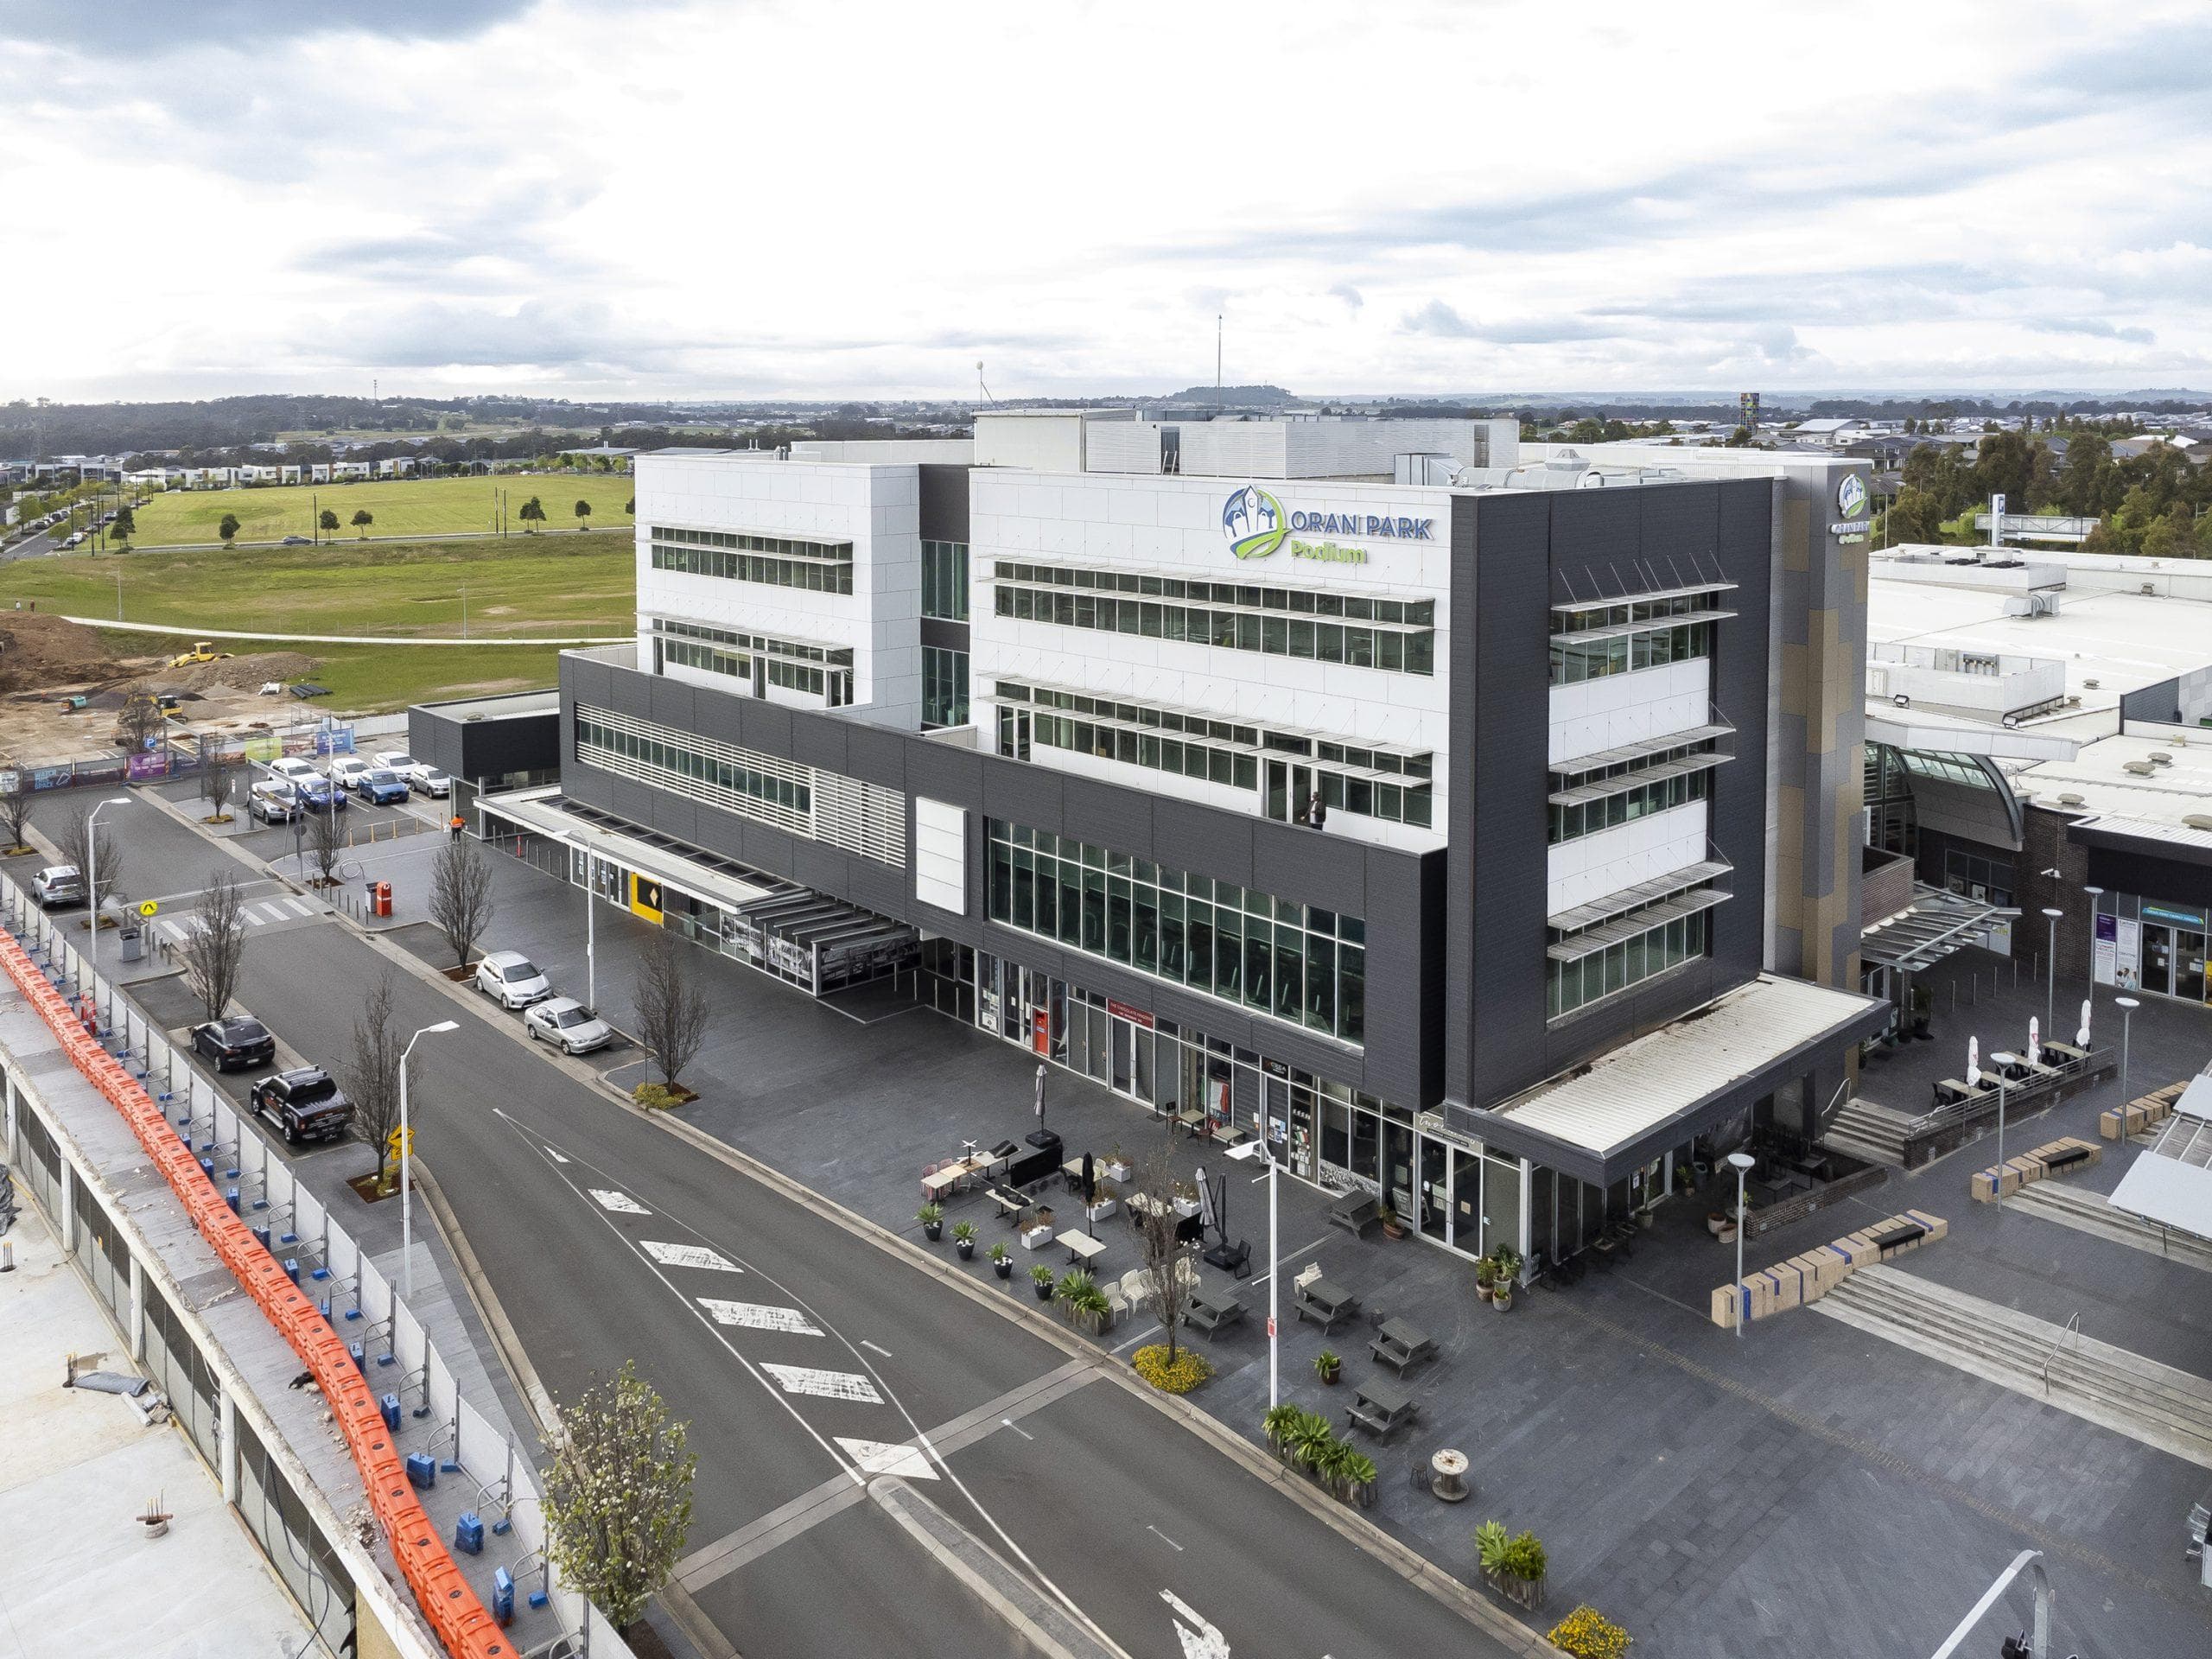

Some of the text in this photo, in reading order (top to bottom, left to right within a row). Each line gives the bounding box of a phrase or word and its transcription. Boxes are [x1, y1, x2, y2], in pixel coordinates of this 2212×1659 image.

[1291, 511, 1432, 540] ORAN PARK
[1291, 540, 1367, 563] Podium
